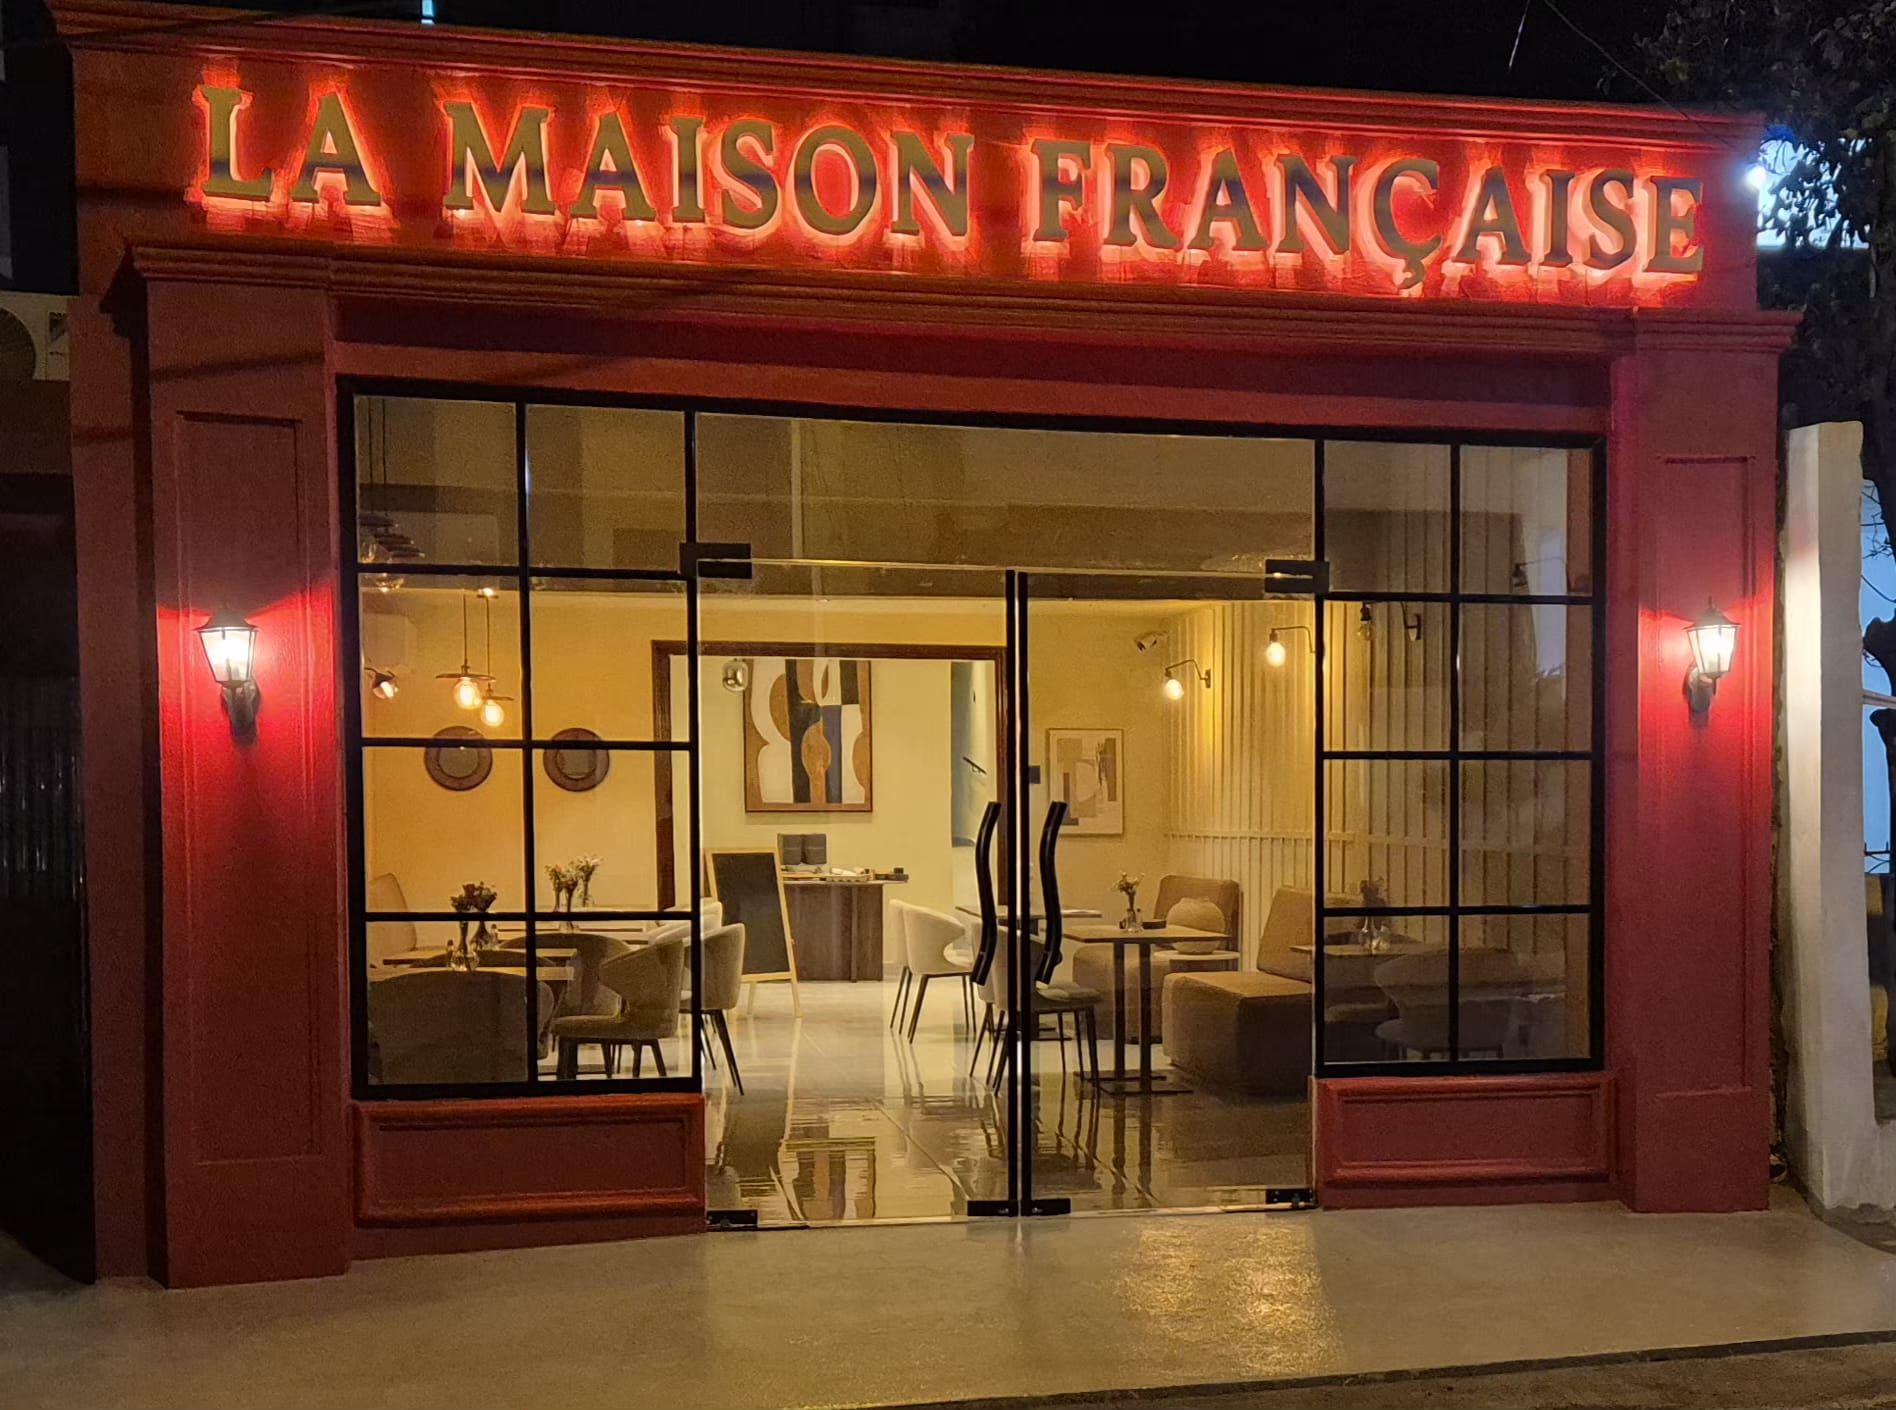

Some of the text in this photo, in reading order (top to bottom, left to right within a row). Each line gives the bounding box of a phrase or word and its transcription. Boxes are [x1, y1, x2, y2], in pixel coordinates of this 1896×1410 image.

[199, 87, 1703, 288] LA MAISON FRANÇAISE
